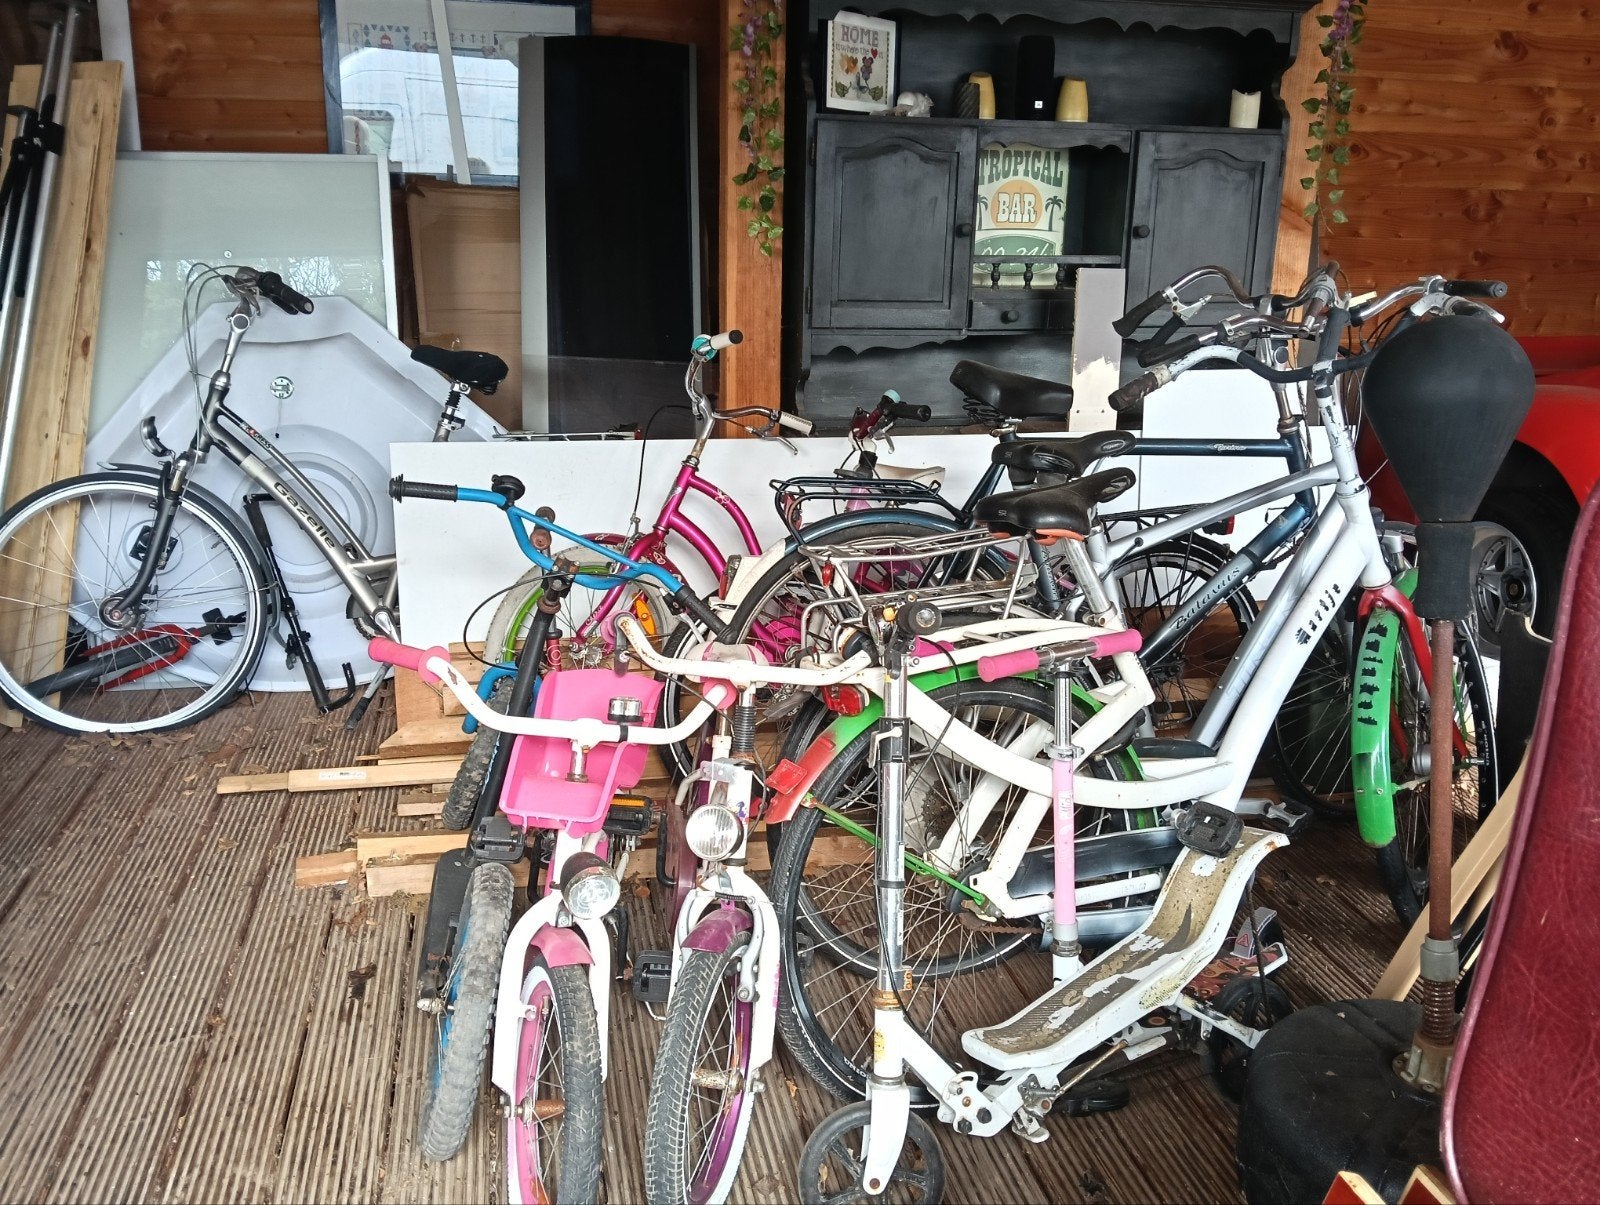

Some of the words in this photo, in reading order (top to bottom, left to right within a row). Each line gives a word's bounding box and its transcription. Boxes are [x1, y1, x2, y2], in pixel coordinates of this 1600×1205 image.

[841, 24, 879, 47] HOME
[860, 48, 870, 56] the
[978, 149, 1064, 187] TROPICAL
[996, 192, 1037, 223] BAR
[273, 481, 335, 549] Gazelle
[1169, 567, 1240, 630] Batavus
